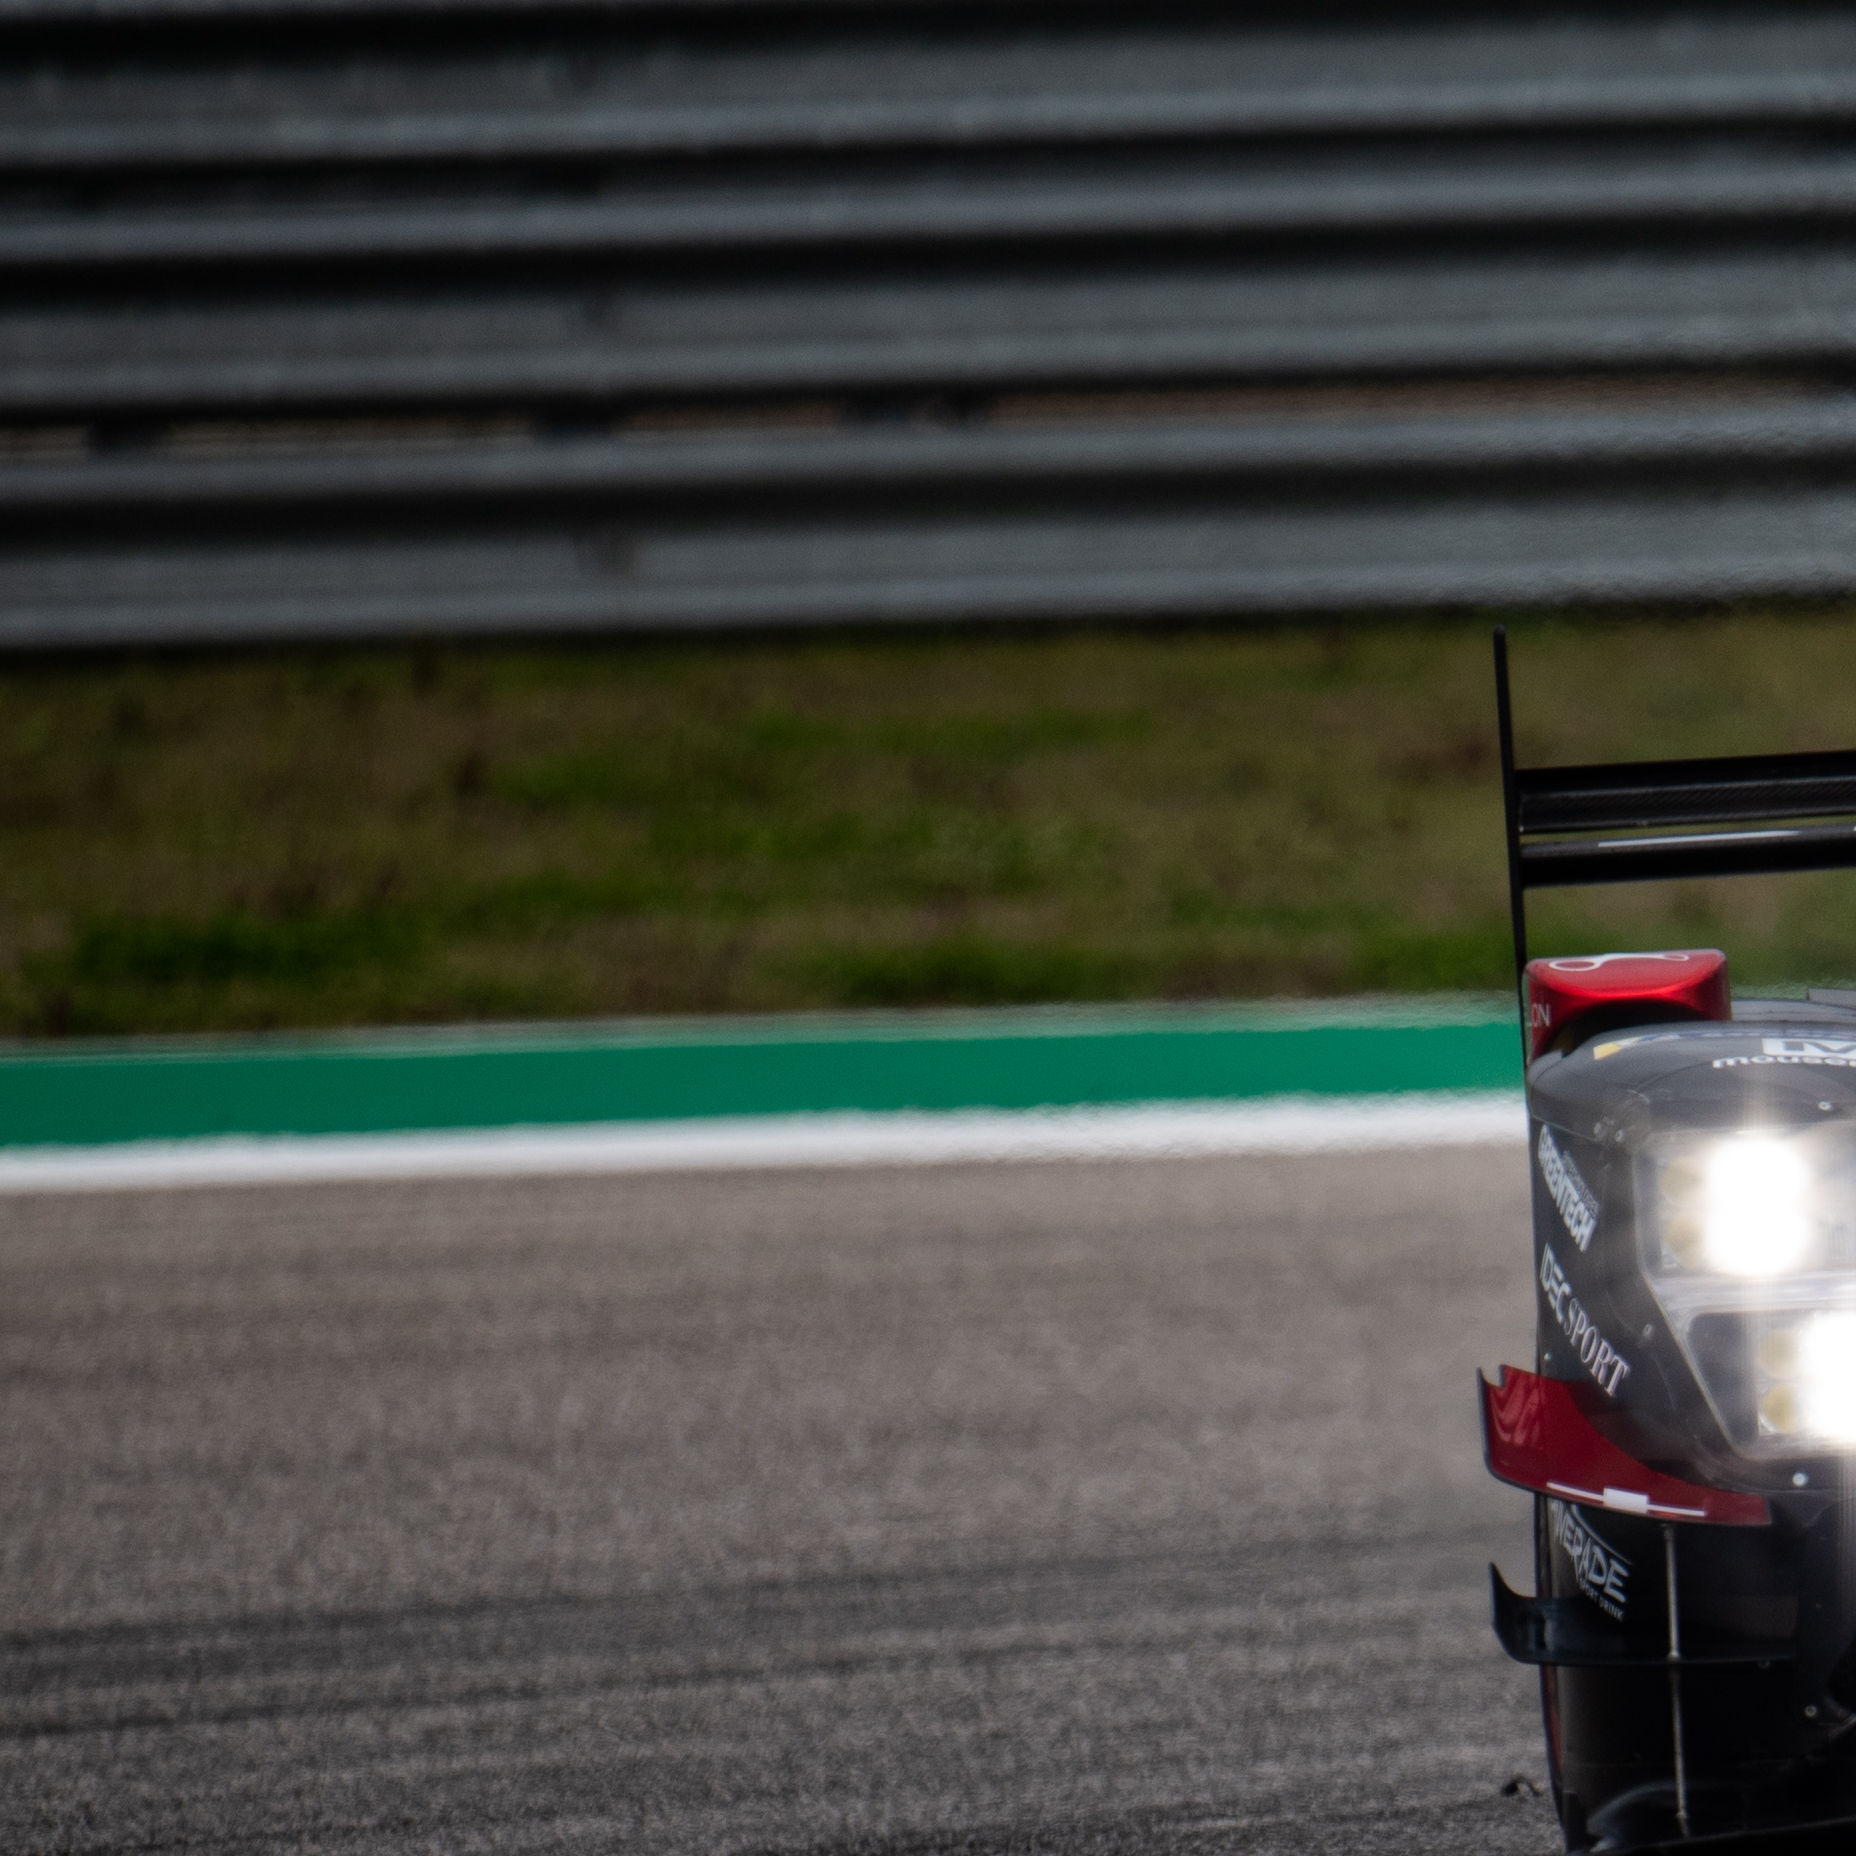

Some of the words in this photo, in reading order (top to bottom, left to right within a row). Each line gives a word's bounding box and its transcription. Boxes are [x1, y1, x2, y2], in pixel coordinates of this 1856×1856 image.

[1538, 1123, 1598, 1252] GREENTECH
[1540, 1242, 1573, 1326] IDEC
[1563, 1297, 1631, 1398] SPORT
[1599, 1595, 1625, 1622] DRINK
